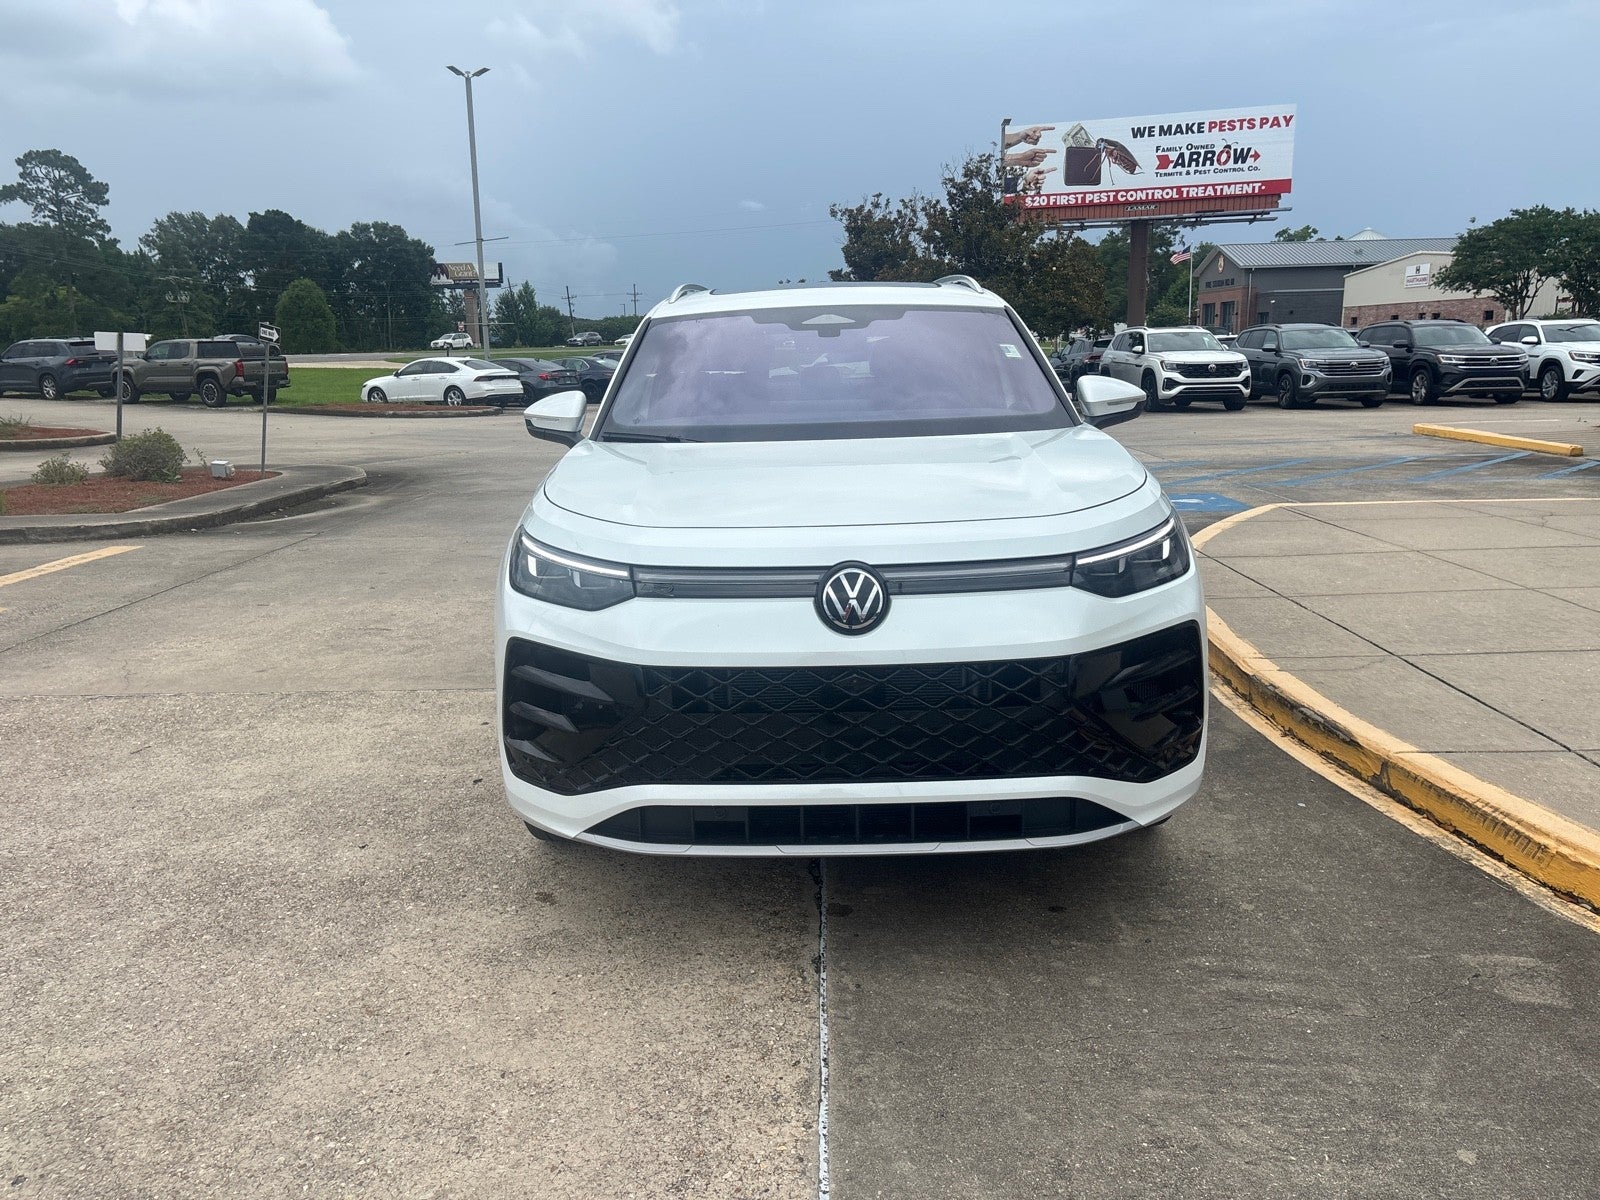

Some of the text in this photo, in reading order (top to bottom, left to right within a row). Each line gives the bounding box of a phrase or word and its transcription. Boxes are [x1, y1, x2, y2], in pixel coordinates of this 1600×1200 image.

[1131, 114, 1295, 139] WE MAKE PESTS PAY
[1172, 146, 1252, 169] ARROW
[1025, 195, 1048, 208] $20
[1049, 193, 1084, 206] FIRST
[1085, 191, 1116, 204] PEST
[1117, 187, 1179, 202] CONTROL
